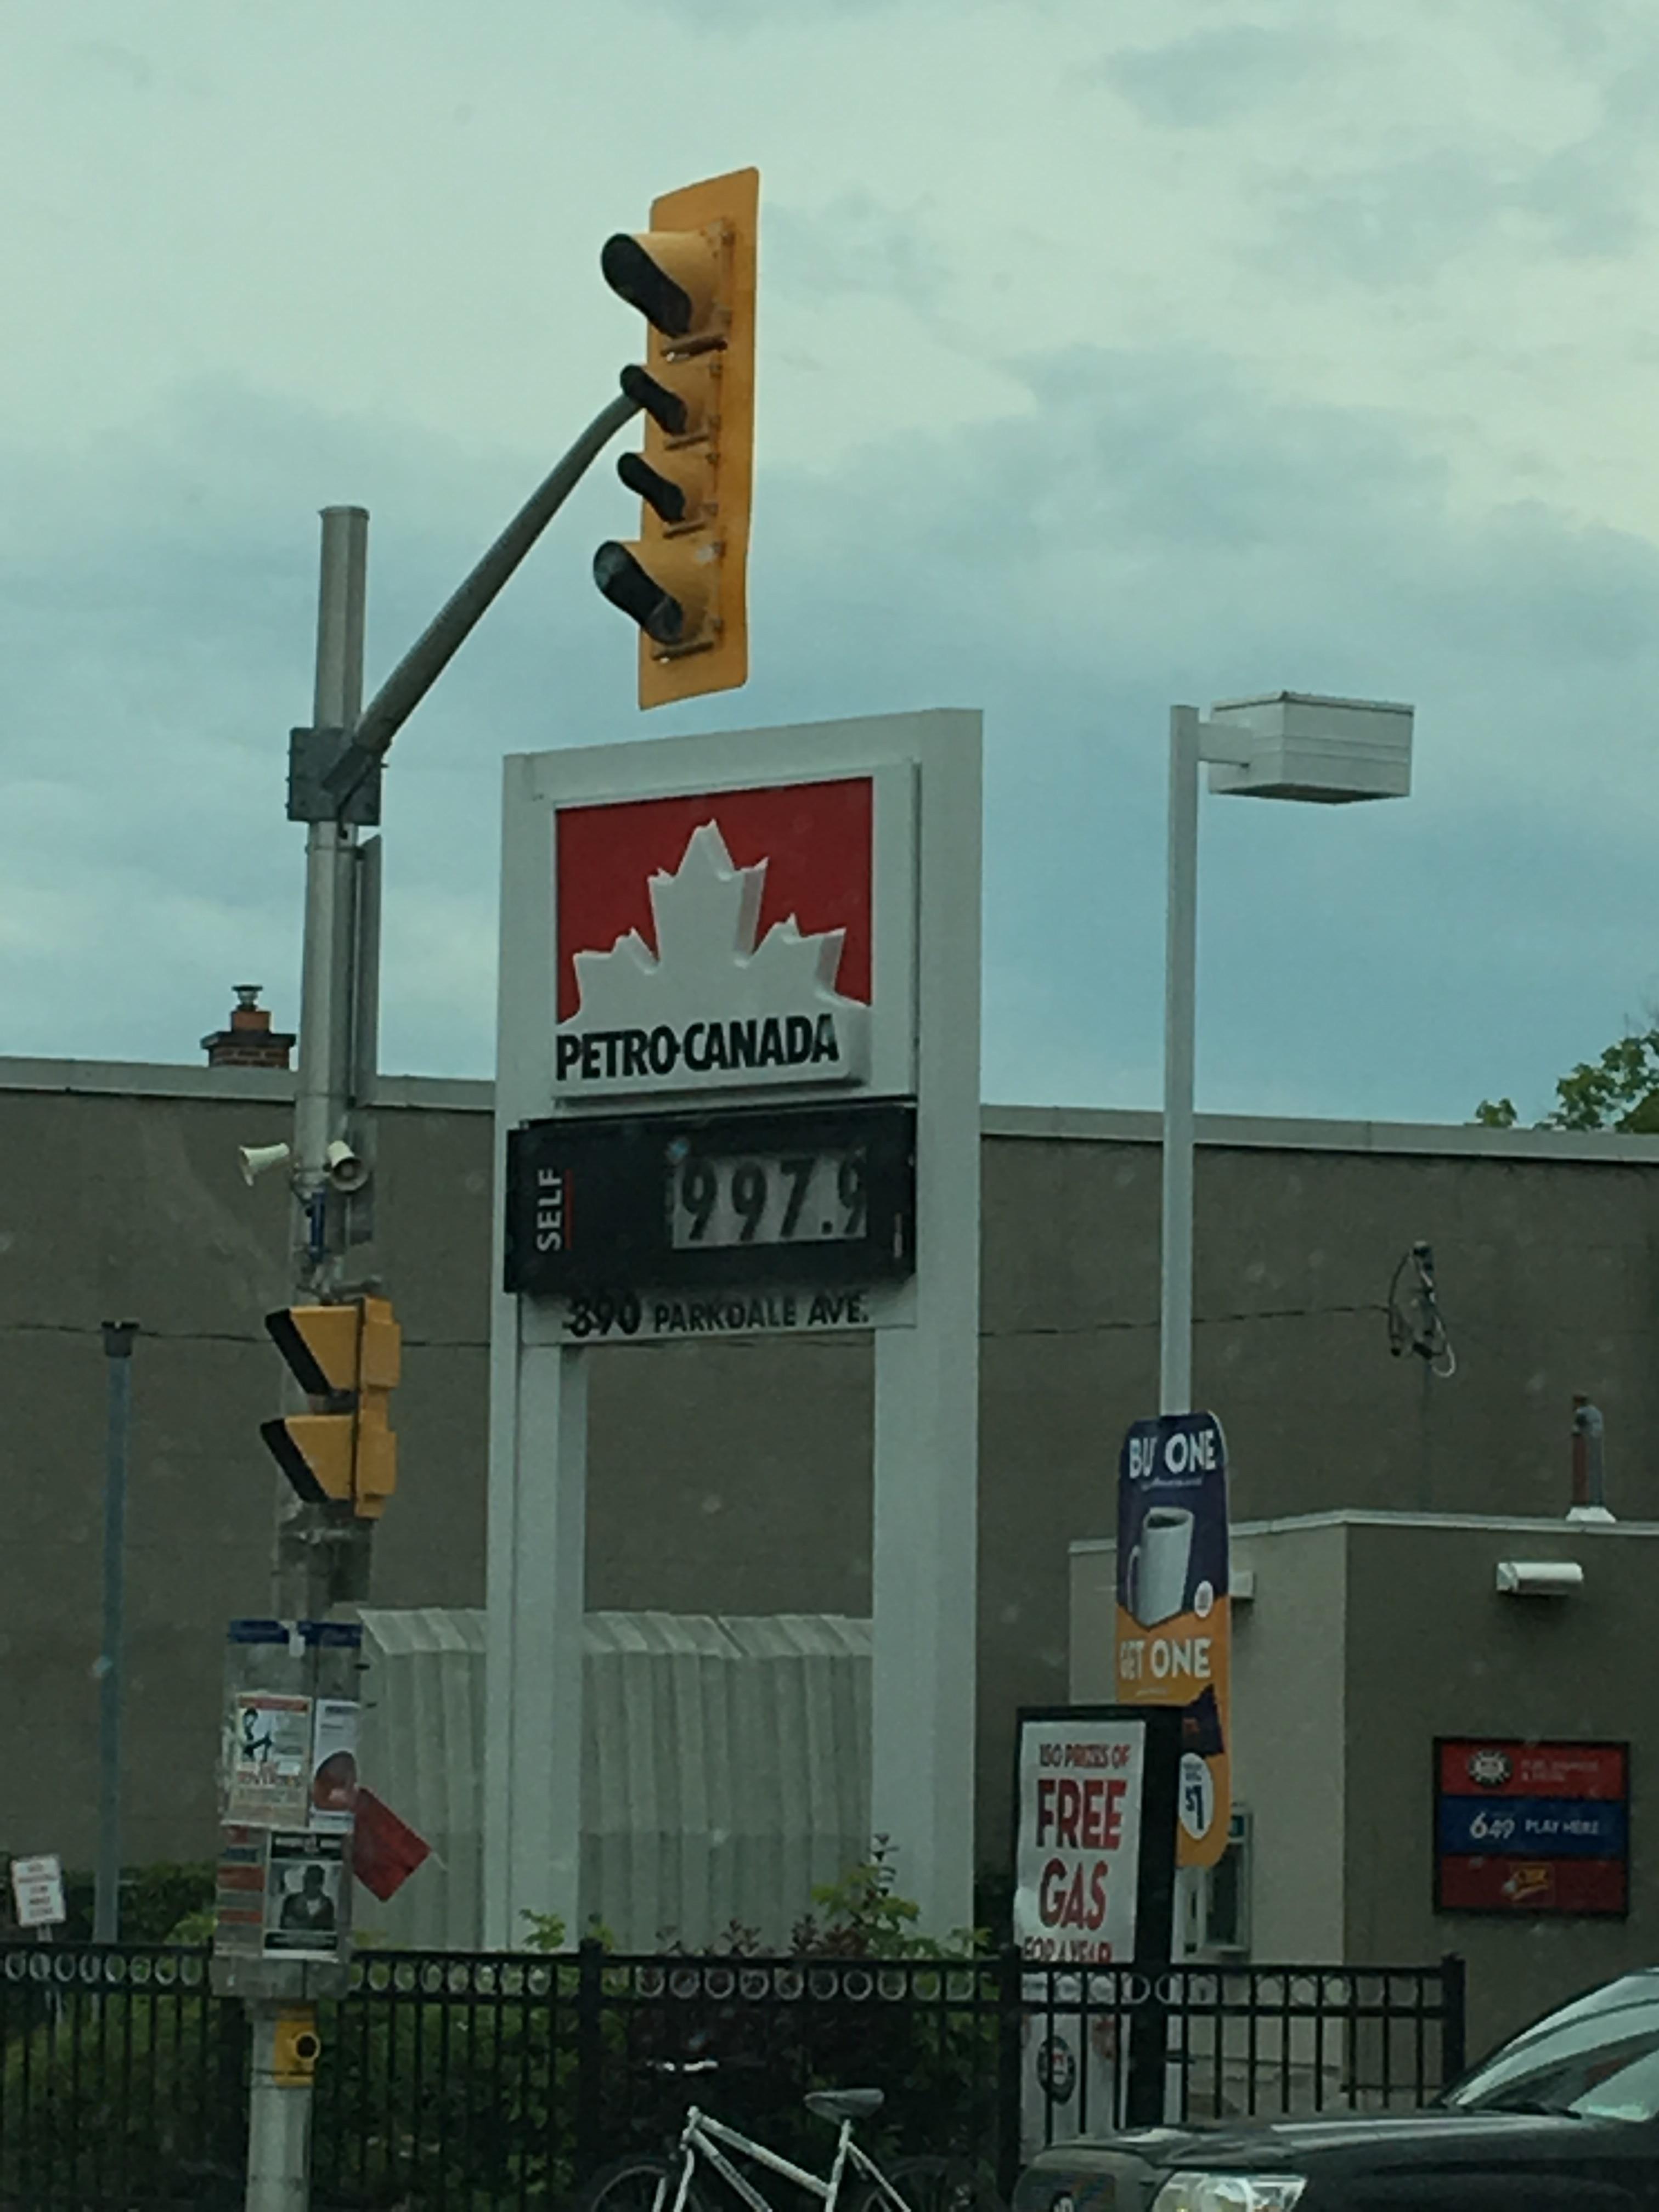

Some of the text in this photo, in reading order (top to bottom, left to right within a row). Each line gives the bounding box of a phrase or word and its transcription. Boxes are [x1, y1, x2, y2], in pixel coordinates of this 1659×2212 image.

[537, 1168, 562, 1251] SELF
[654, 1297, 795, 1333] PARKDALE
[1164, 1429, 1216, 1474] ONE
[1150, 1638, 1212, 1679] ONE
[1036, 1778, 1127, 1850] FREE
[1525, 1819, 1560, 1834] PLAY
[1039, 1858, 1108, 1931] GAS
